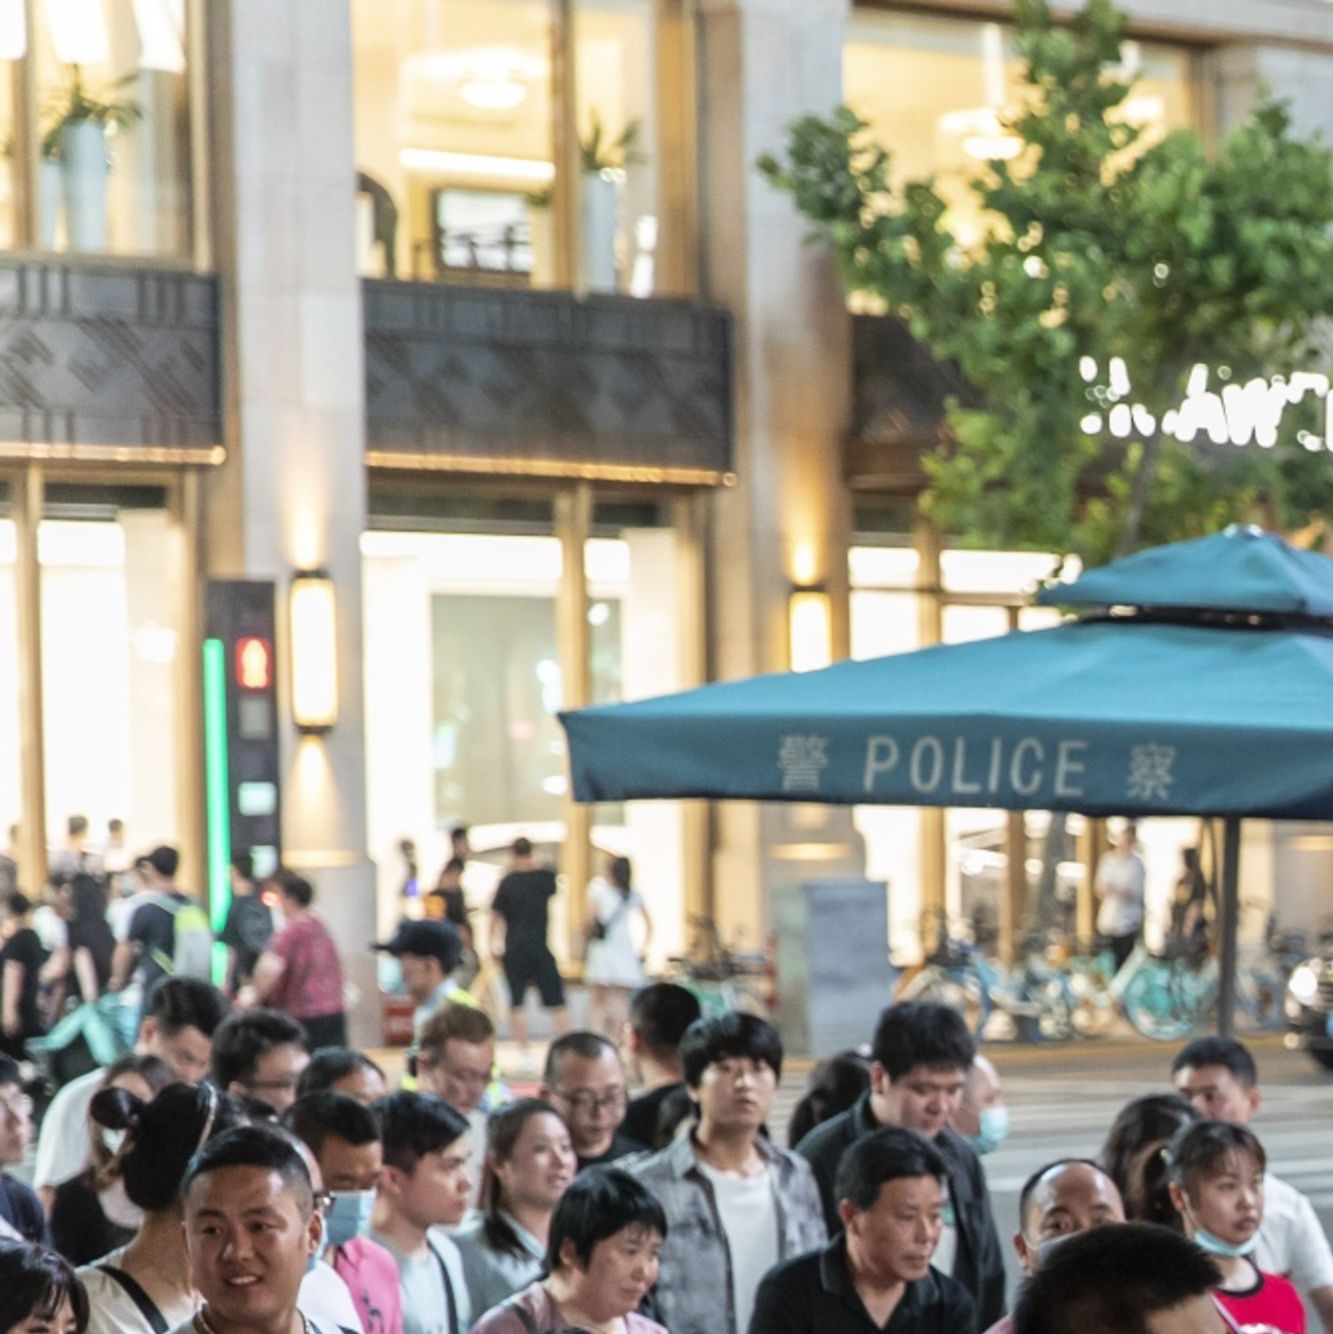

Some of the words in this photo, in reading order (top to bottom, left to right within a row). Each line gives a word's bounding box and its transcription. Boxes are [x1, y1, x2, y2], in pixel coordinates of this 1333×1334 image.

[777, 735, 829, 792] 警
[863, 735, 1089, 797] POLICE
[1127, 742, 1177, 799] 察
